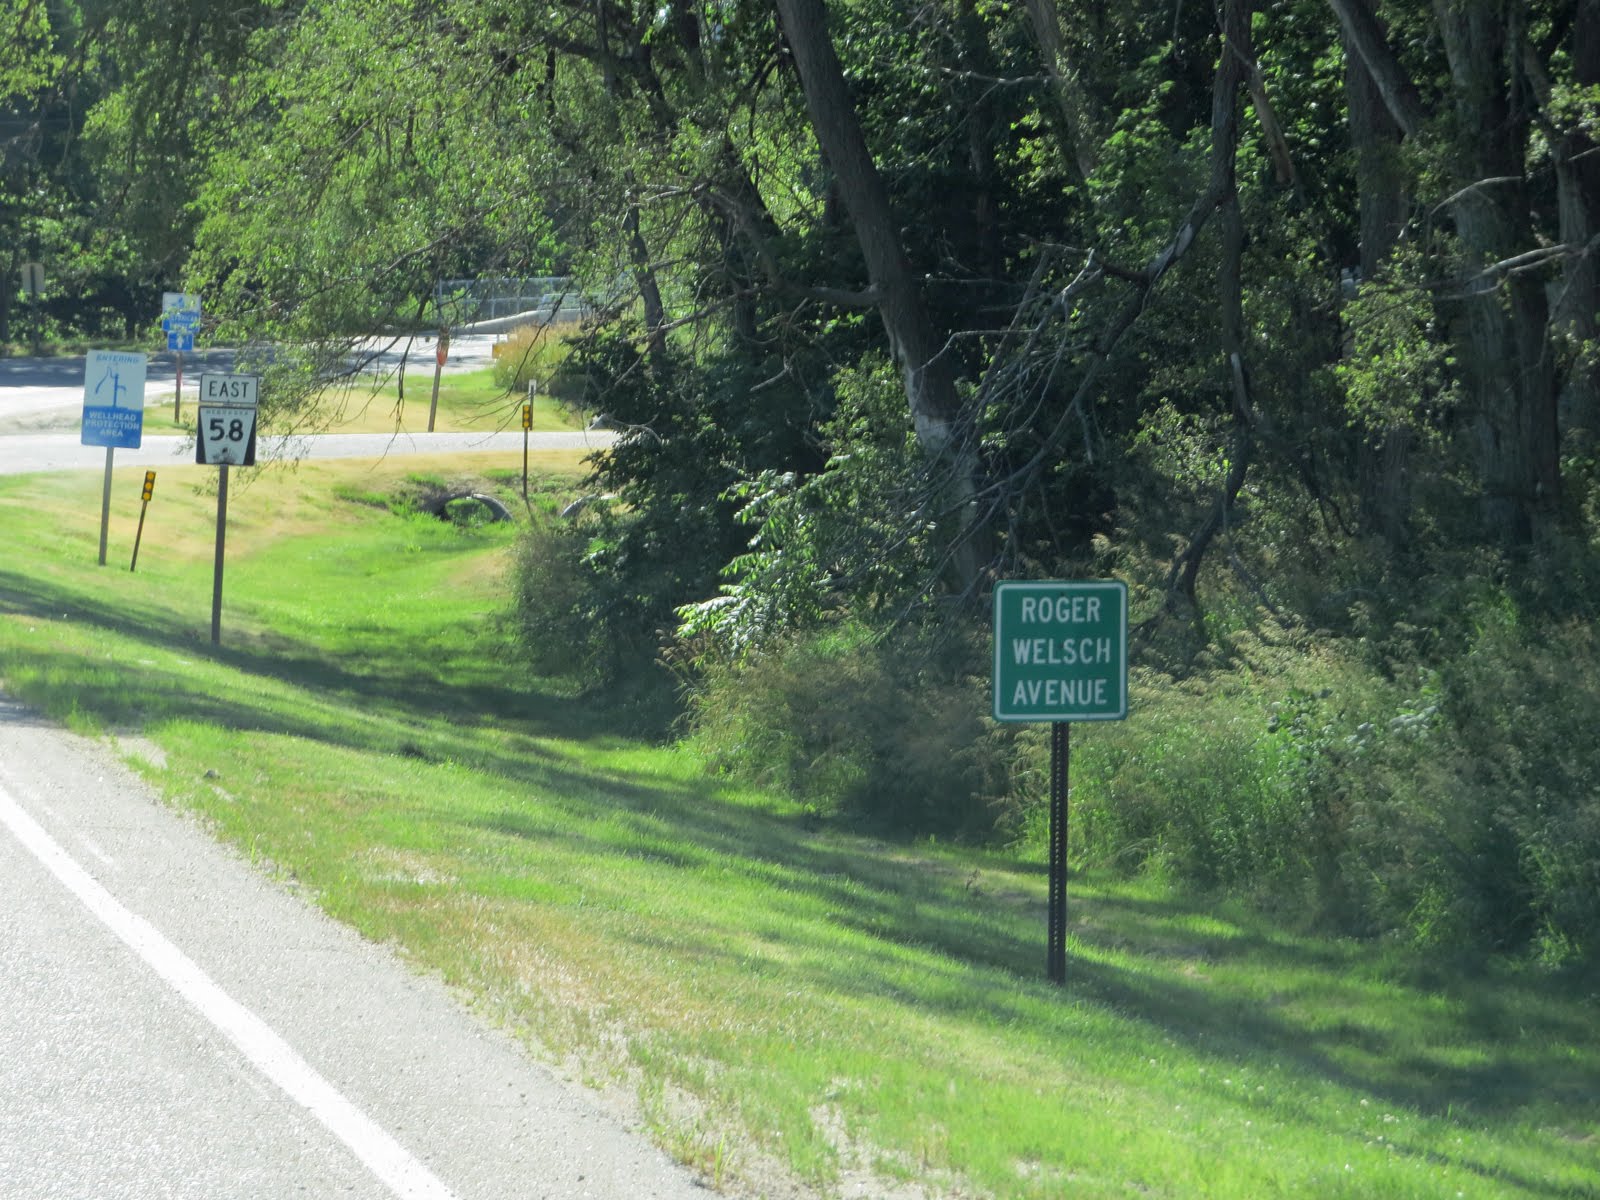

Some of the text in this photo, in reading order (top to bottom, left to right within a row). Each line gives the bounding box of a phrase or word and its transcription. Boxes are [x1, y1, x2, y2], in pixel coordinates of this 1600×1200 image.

[208, 380, 250, 398] EAST
[85, 419, 139, 430] PROTECTION
[89, 411, 137, 421] WELLHEAD
[99, 428, 124, 438] AREA
[209, 418, 244, 442] 58
[1022, 597, 1101, 623] ROGER
[1012, 637, 1111, 665] WELSCH
[1012, 679, 1108, 705] AVENUE
